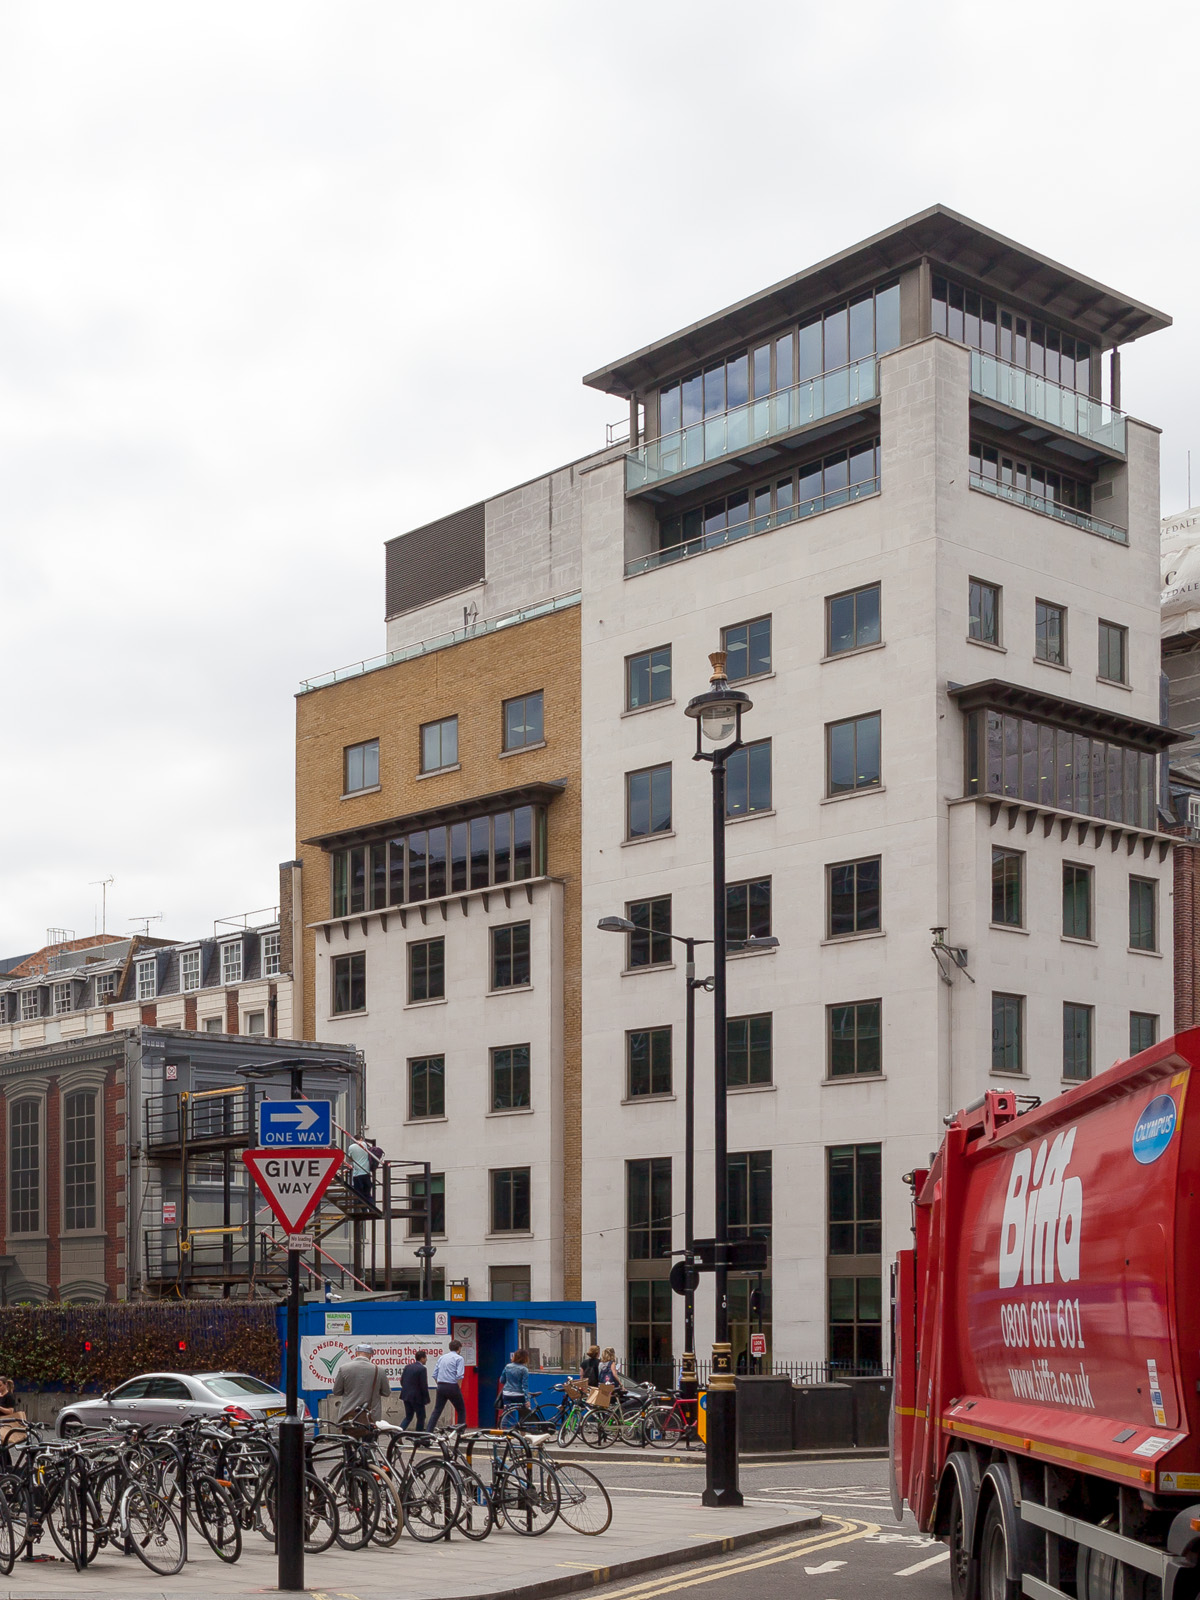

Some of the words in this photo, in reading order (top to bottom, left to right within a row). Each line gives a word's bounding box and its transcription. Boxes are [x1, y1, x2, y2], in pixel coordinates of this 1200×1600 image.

[265, 1132, 293, 1143] ONE
[297, 1131, 325, 1142] WAY
[1135, 1113, 1174, 1143] OLYMPUS
[264, 1159, 321, 1178] GIVE
[277, 1182, 313, 1194] WAY
[999, 1125, 1083, 1289] Biffa
[1000, 1303, 1030, 1348] 0800
[1030, 1300, 1056, 1348] 601
[1057, 1298, 1085, 1349] 601
[372, 1347, 403, 1357] proving
[404, 1346, 416, 1356] the
[371, 1357, 416, 1367] constructio
[1008, 1359, 1095, 1409] www.biffa.co.uk
